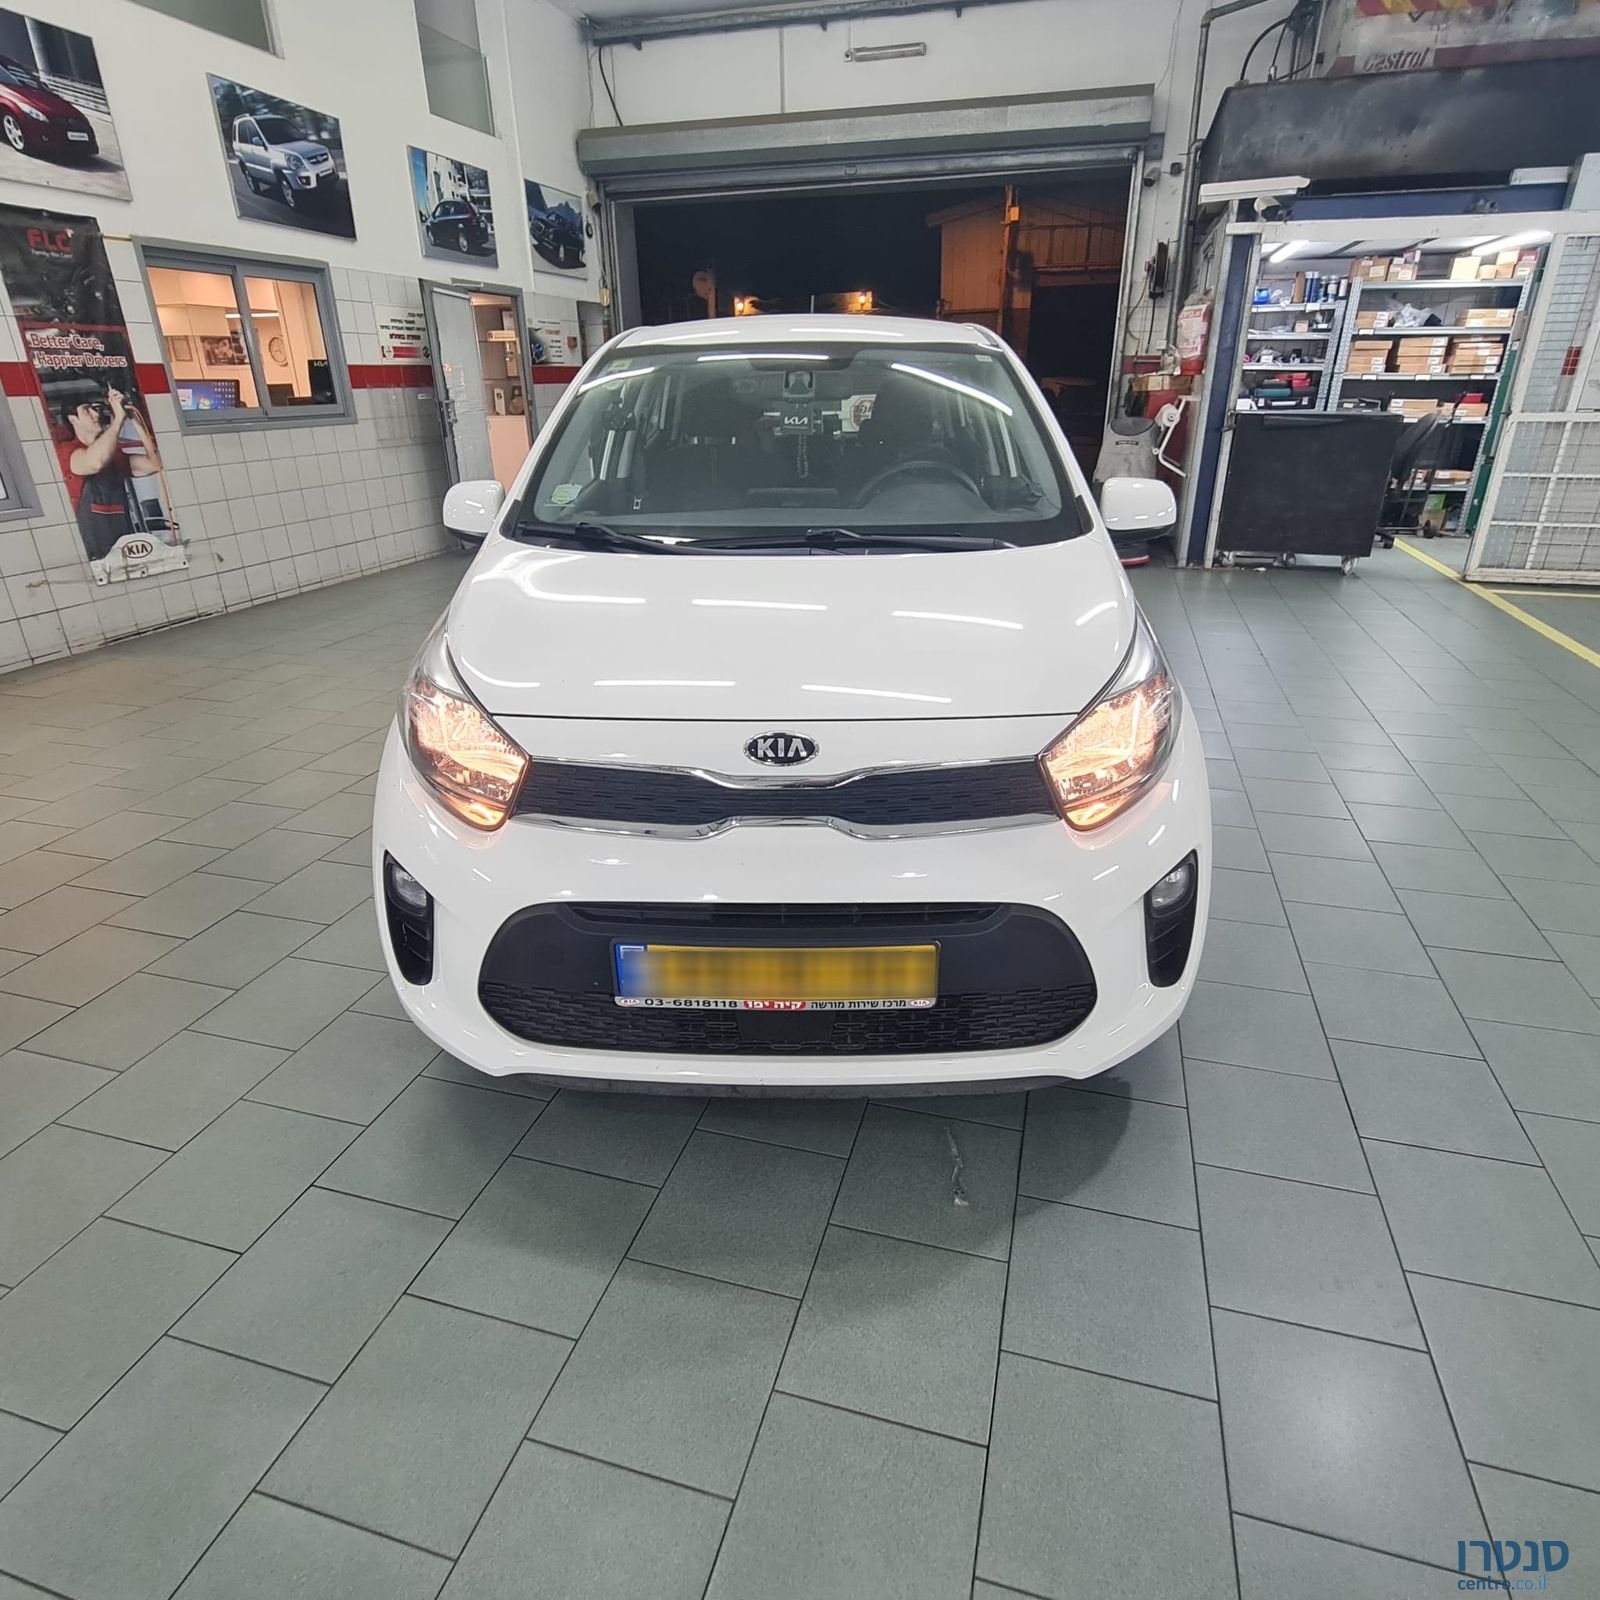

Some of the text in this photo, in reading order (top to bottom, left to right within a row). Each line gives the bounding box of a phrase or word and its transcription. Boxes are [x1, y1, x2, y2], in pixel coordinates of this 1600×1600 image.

[29, 332, 104, 351] Better Care,
[35, 351, 128, 369] Happier Drivers
[784, 416, 808, 425] KIA
[126, 542, 149, 556] KIA
[757, 738, 807, 758] KIA
[644, 998, 738, 1008] 03-6818118
[747, 1001, 770, 1009] יפו
[774, 1001, 802, 1010] קיה
[811, 1001, 845, 1009] מורשה
[848, 1001, 879, 1009] שירות
[882, 1000, 907, 1008] מרכז
